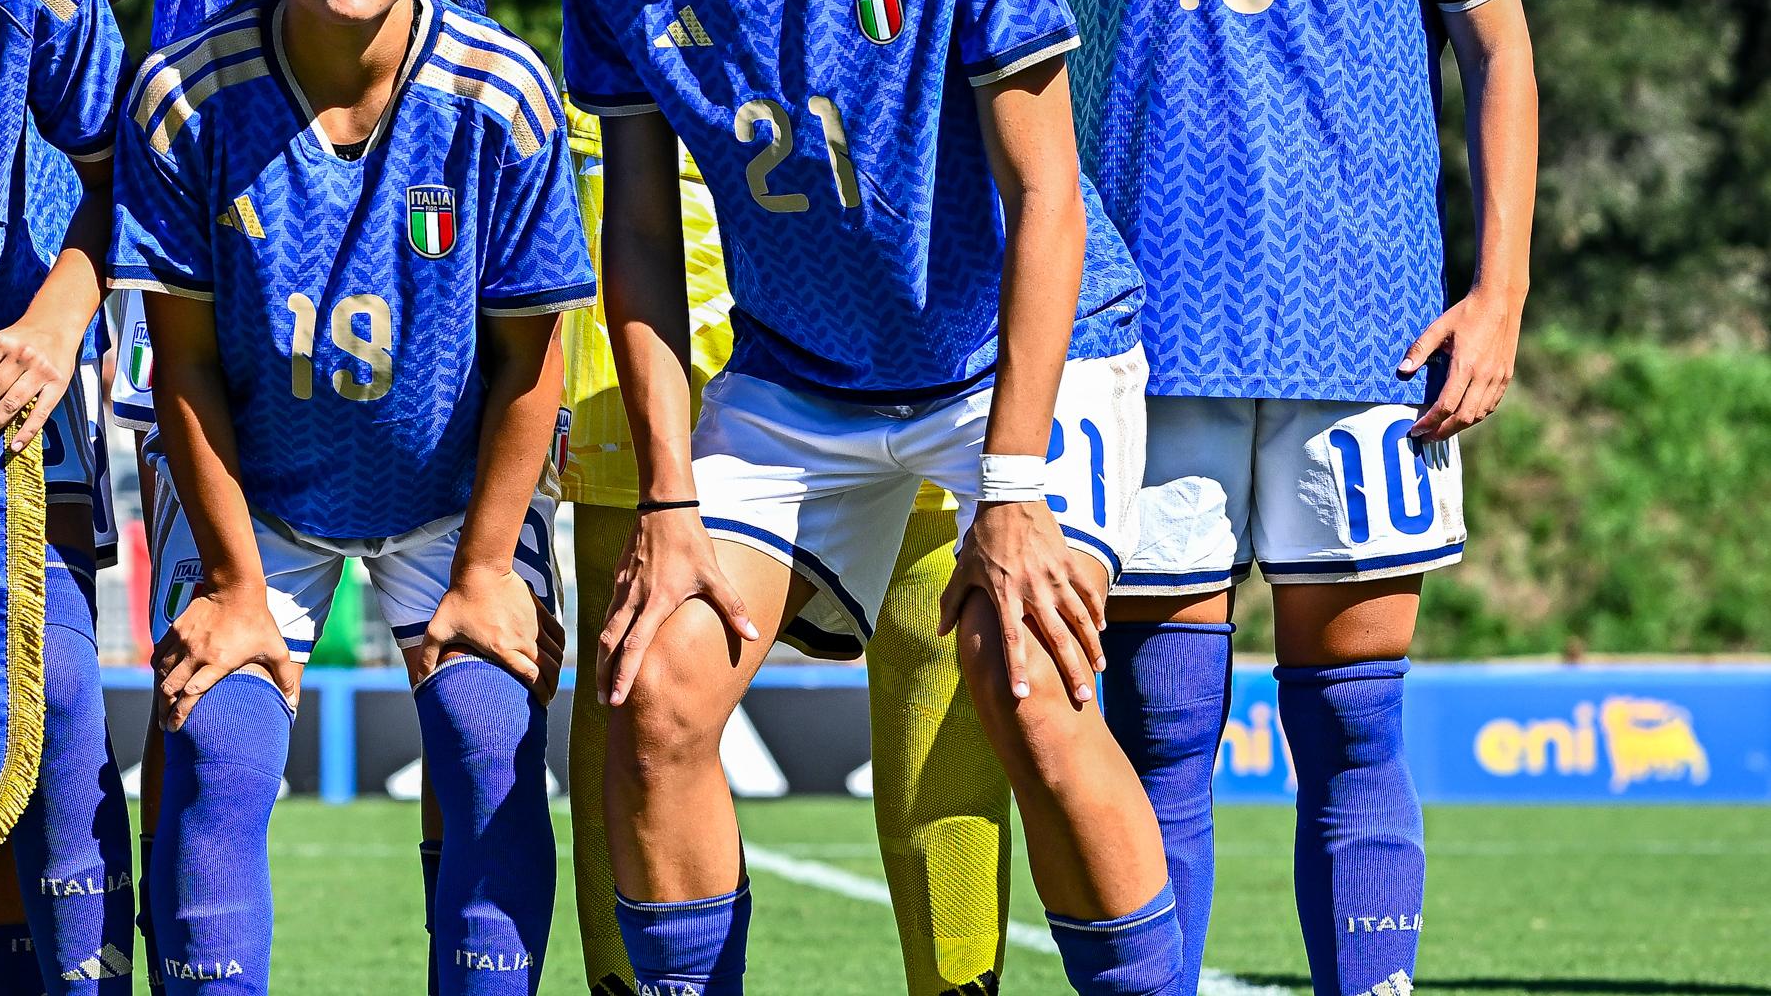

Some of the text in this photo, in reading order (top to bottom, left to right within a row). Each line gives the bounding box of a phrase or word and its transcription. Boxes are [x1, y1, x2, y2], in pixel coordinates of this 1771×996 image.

[735, 96, 860, 212] 21
[411, 191, 451, 206] ITALIA
[288, 292, 393, 401] 19
[1330, 419, 1435, 543] 10
[1214, 703, 1273, 775] ni
[1475, 701, 1596, 775] eni
[41, 870, 133, 897] ITALIA
[166, 957, 243, 981] ITALIA
[456, 948, 534, 972] ITALIA
